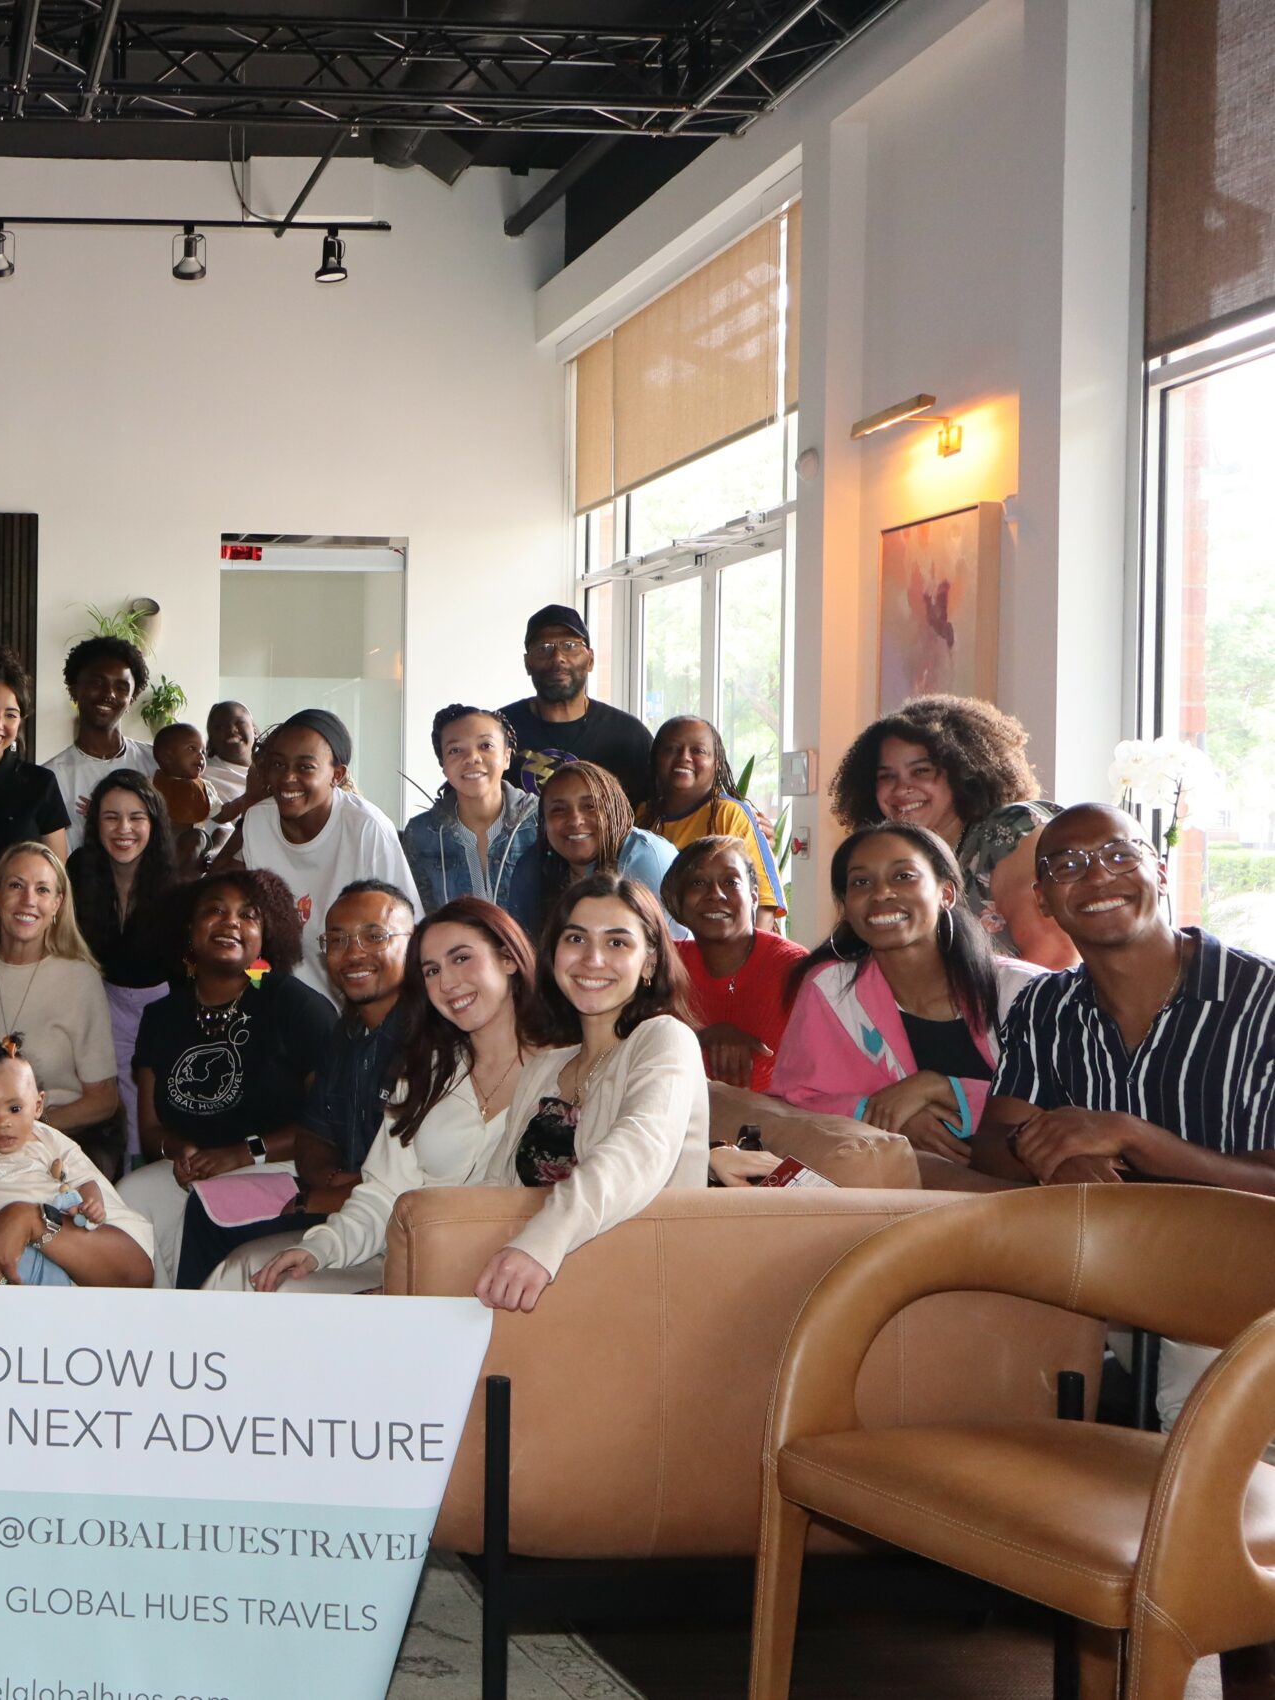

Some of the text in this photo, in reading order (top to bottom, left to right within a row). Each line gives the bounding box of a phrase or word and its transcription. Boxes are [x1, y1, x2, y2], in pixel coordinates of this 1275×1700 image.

[167, 1077, 194, 1109] GLOBAL
[223, 1071, 243, 1105] TRAVEL
[169, 1350, 228, 1392] US
[7, 1406, 133, 1450] NEXT
[143, 1412, 445, 1463] ADVENTURE
[5, 1585, 136, 1619] GLOBAL
[145, 1592, 229, 1624] HUES
[238, 1597, 378, 1632] TRAVELS
